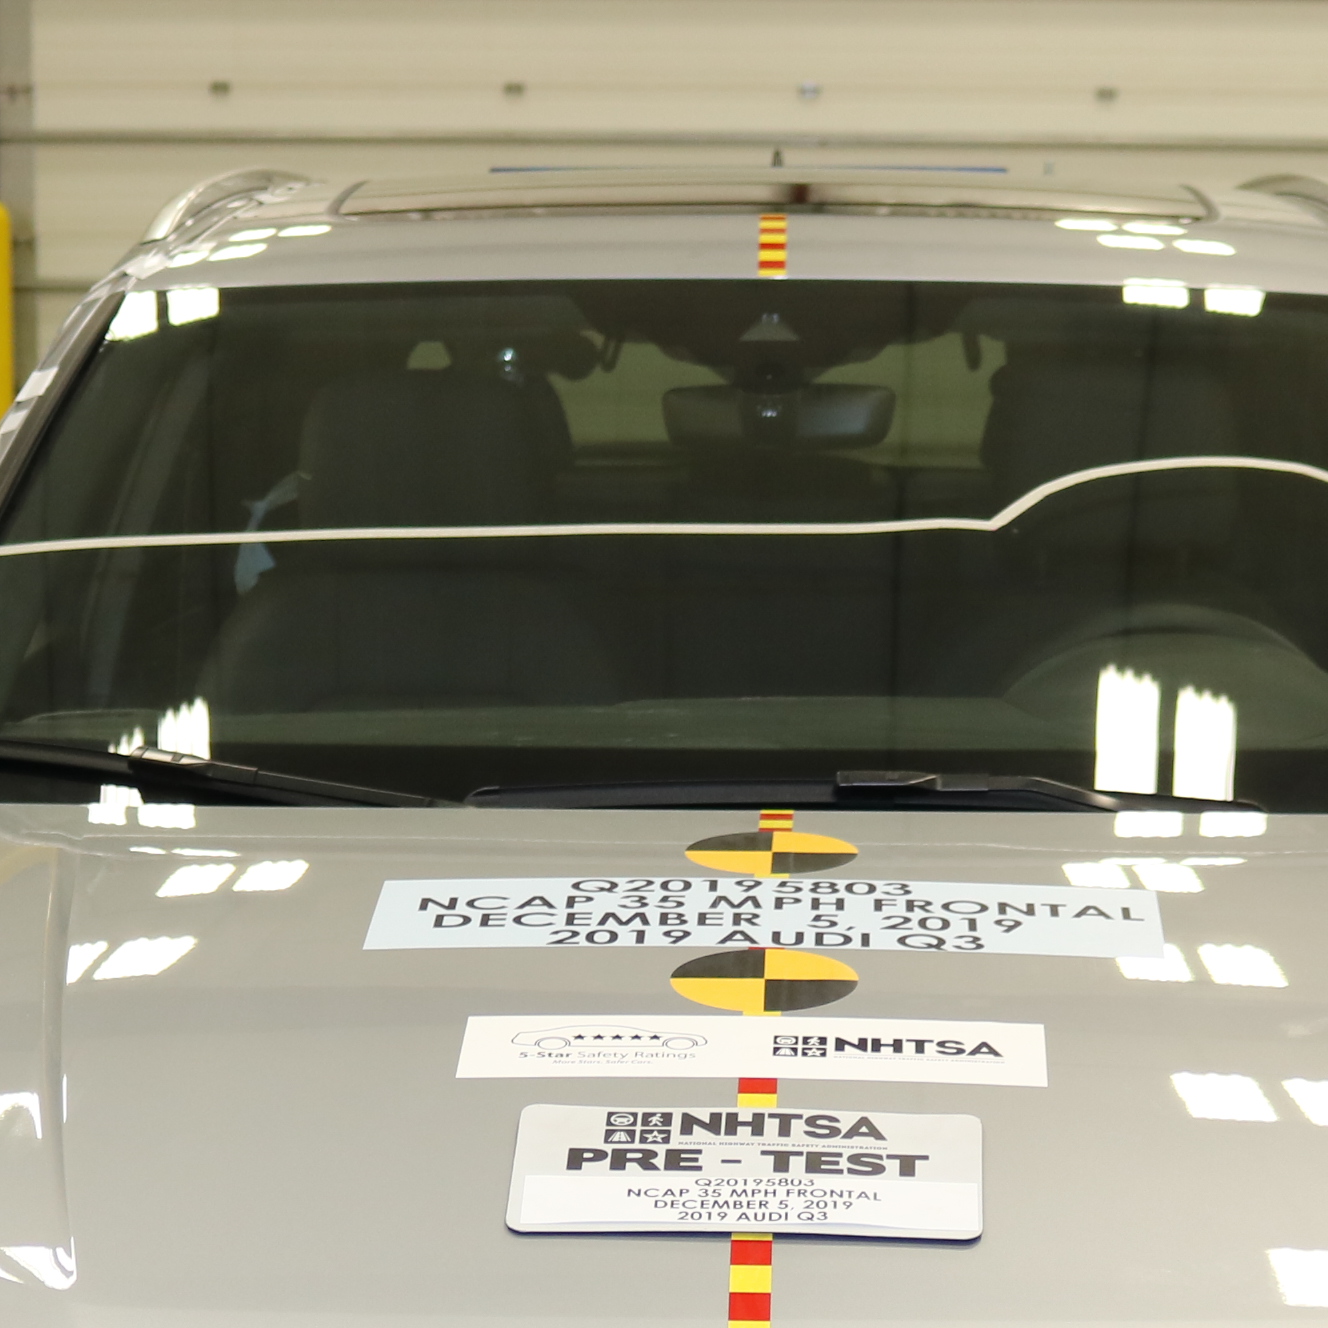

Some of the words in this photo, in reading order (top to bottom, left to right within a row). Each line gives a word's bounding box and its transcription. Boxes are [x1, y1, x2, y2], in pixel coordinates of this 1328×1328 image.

[571, 878, 912, 896] Q20195803
[417, 895, 595, 911] NCAP
[617, 895, 686, 909] 35
[709, 895, 846, 912] MPH
[872, 898, 1146, 922] FRONTAL
[432, 911, 762, 929] DECEMBER
[807, 914, 856, 932] 5,
[880, 915, 1023, 933] 2019
[546, 929, 692, 946] 2019
[715, 930, 871, 947] AUDI
[895, 934, 986, 952] Q3
[518, 1051, 572, 1059] 5-Star
[577, 1051, 629, 1060] Safety
[635, 1051, 697, 1060] Ratings
[834, 1036, 1004, 1058] NHTSA
[679, 1112, 888, 1141] NHTSA
[566, 1147, 703, 1172] PRE
[760, 1149, 930, 1178] TEST
[694, 1178, 815, 1188] Q20195803
[626, 1187, 689, 1198] NCAP
[697, 1188, 723, 1198] 35
[729, 1188, 777, 1199] MPH
[785, 1188, 882, 1202] FRONTAL
[653, 1199, 769, 1210] DECEMBER
[777, 1200, 796, 1212] 5,
[803, 1200, 853, 1210] 2019
[677, 1211, 728, 1222] 2019
[735, 1211, 790, 1222] AUDI
[796, 1211, 829, 1223] Q3
